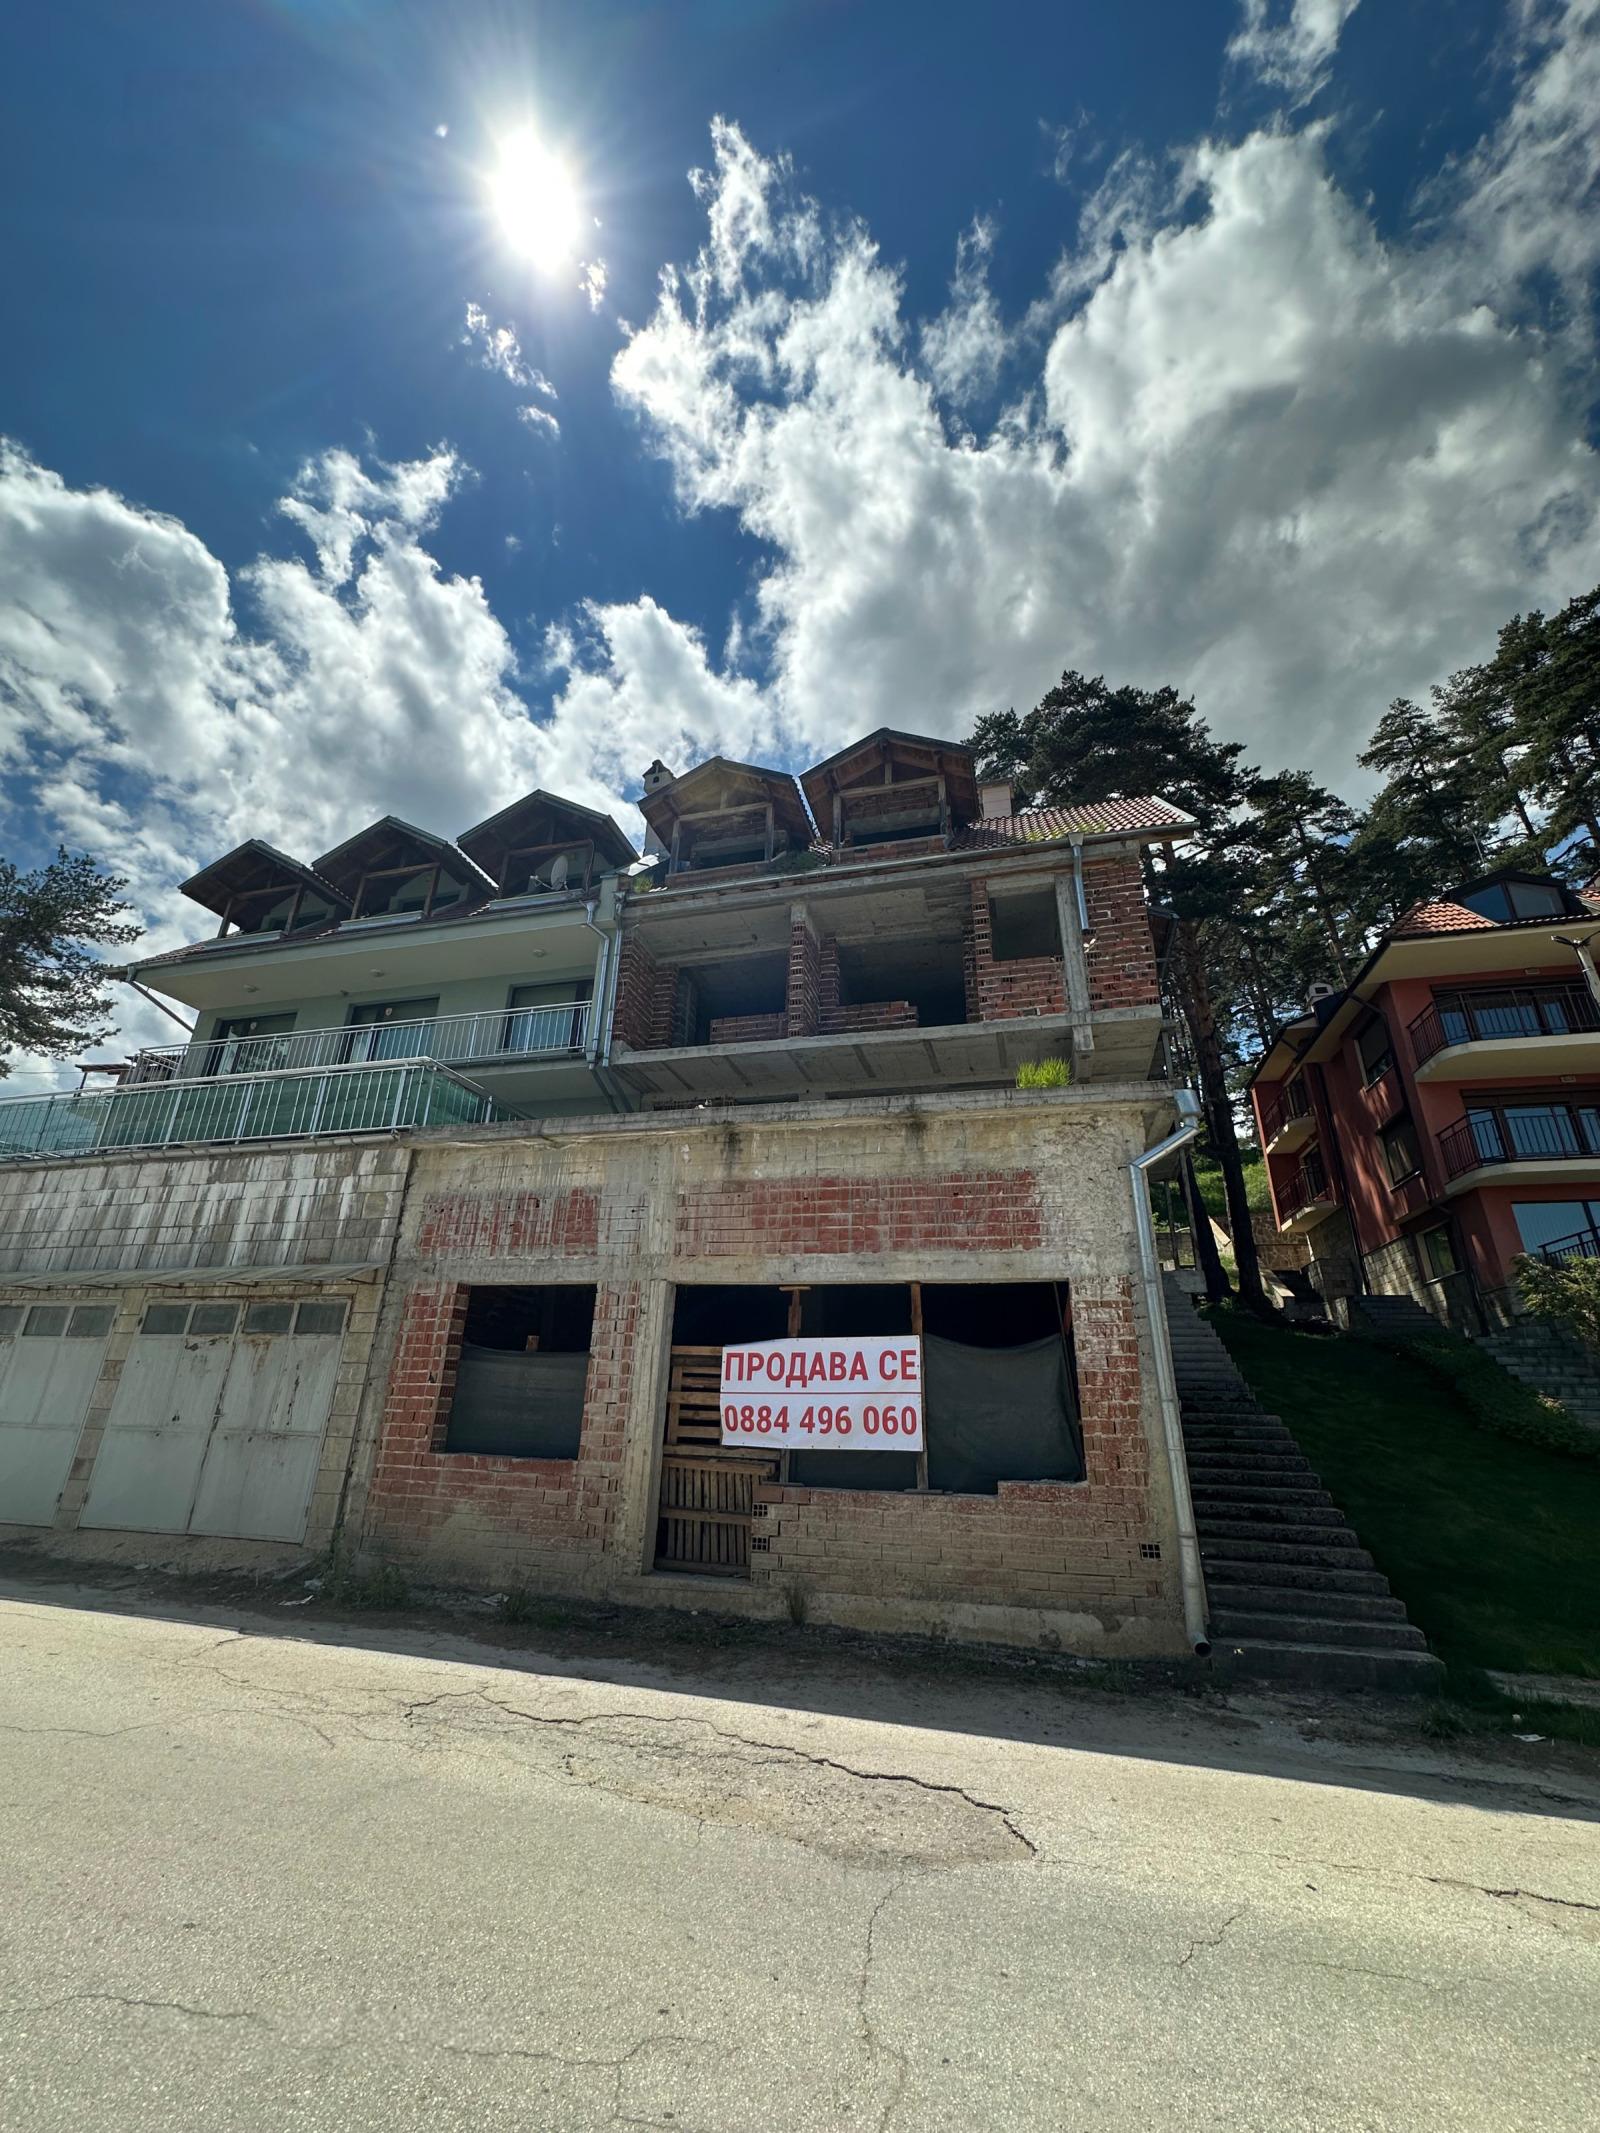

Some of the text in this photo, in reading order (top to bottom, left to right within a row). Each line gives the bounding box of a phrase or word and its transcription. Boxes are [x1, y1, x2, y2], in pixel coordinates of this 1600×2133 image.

[725, 1350, 917, 1388] ПРОДАВА СЕ
[724, 1405, 917, 1435] 0884 496 060
